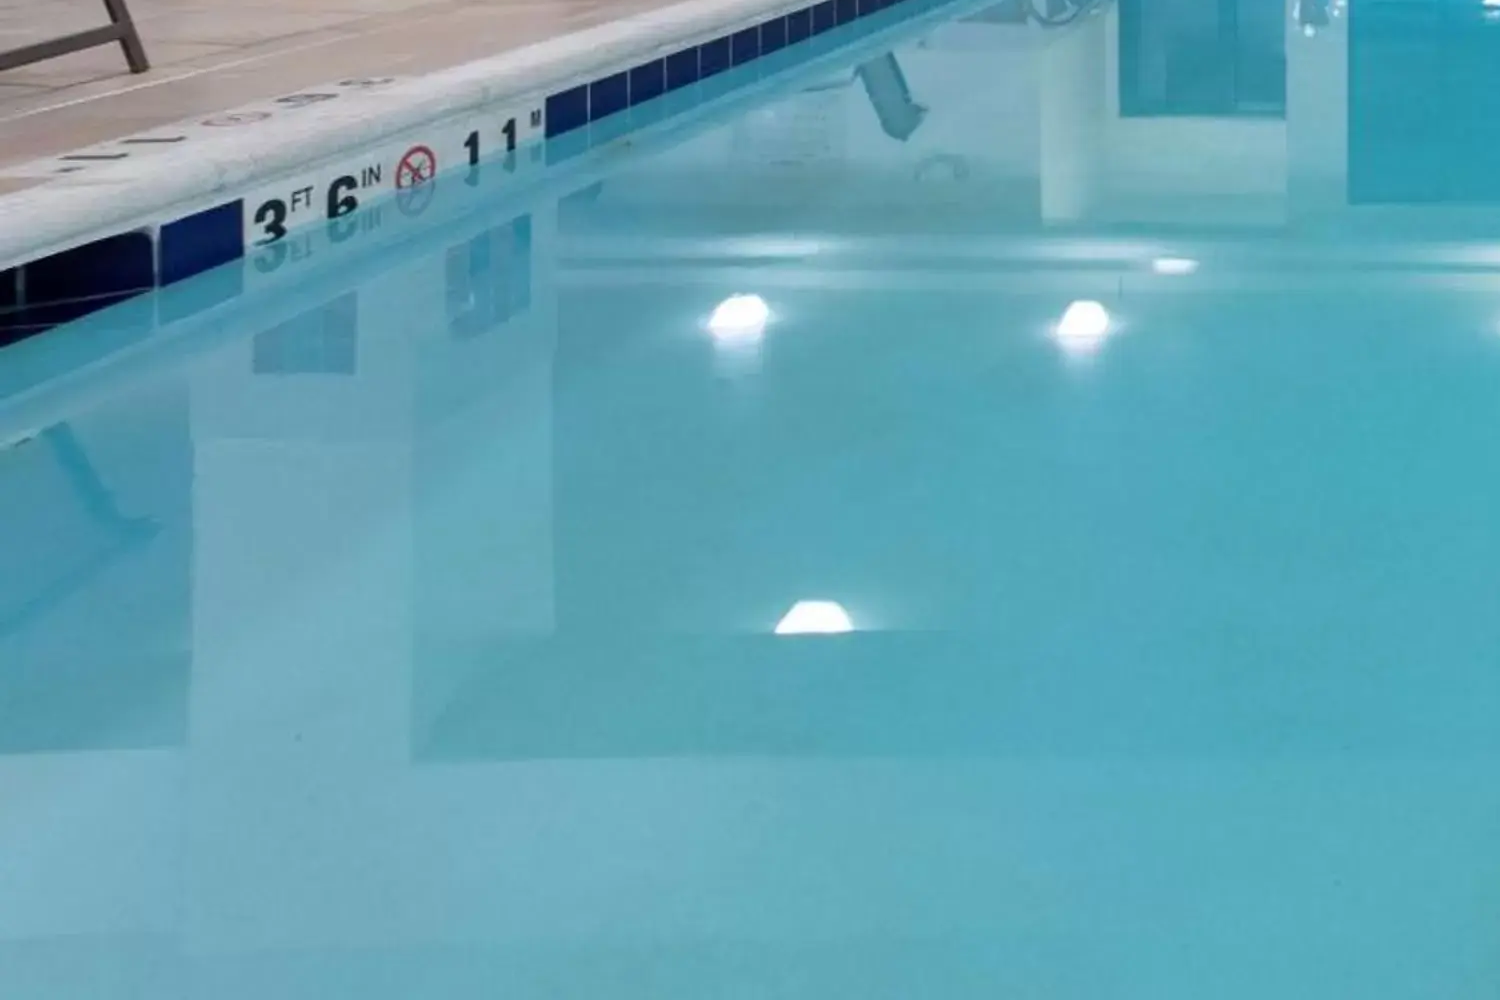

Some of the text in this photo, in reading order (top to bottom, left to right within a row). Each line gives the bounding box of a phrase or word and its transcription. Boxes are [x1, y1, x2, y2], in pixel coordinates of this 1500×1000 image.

[254, 199, 287, 246] 3
[291, 186, 313, 212] FT
[327, 175, 358, 219] 6
[361, 164, 382, 188] IN
